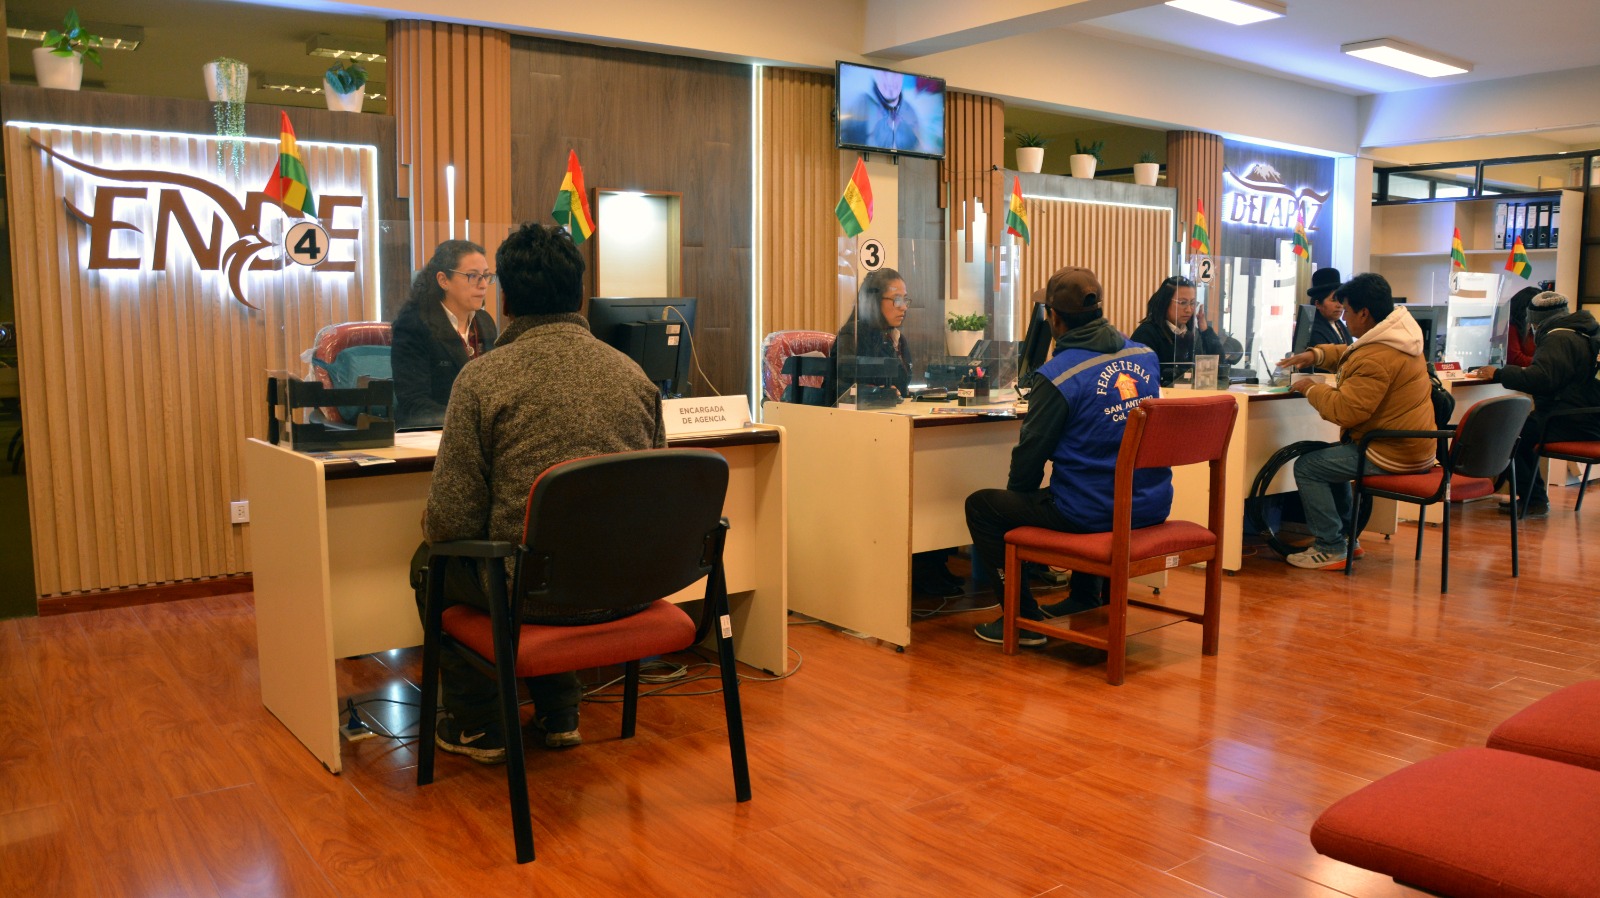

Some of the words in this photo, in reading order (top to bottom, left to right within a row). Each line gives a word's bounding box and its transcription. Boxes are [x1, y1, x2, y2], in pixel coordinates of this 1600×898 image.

[66, 186, 364, 271] ENDE
[293, 228, 321, 260] 4
[865, 243, 880, 267] 3
[1201, 260, 1211, 279] 2
[1096, 360, 1150, 395] FERRETERIA
[679, 405, 725, 414] ENCARGADA
[694, 415, 726, 423] AGENCIA
[1104, 404, 1123, 414] SAN
